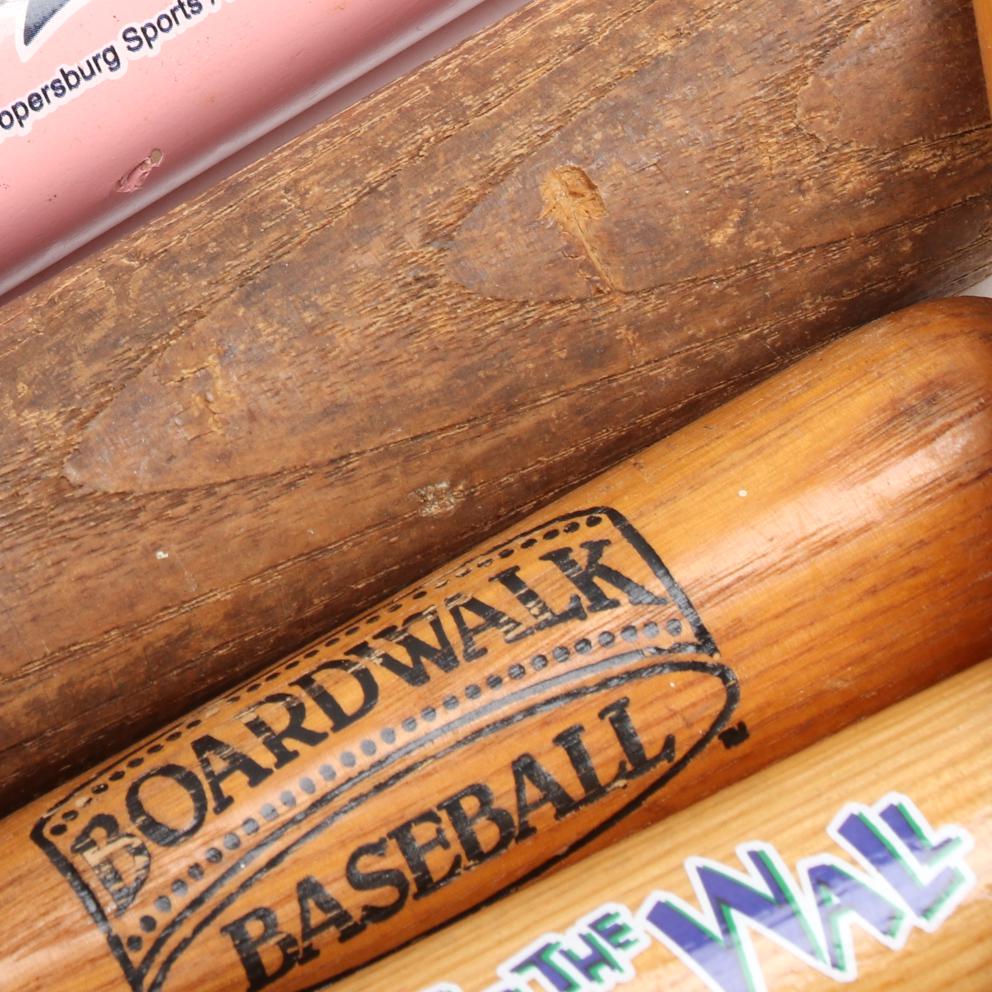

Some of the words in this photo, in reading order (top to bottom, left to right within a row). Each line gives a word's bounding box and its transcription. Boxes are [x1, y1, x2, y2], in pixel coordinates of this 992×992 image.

[72, 538, 667, 914] BOARDWALK
[220, 694, 677, 992] BASEBALL
[508, 911, 640, 992] THE
[644, 799, 968, 992] WALL
